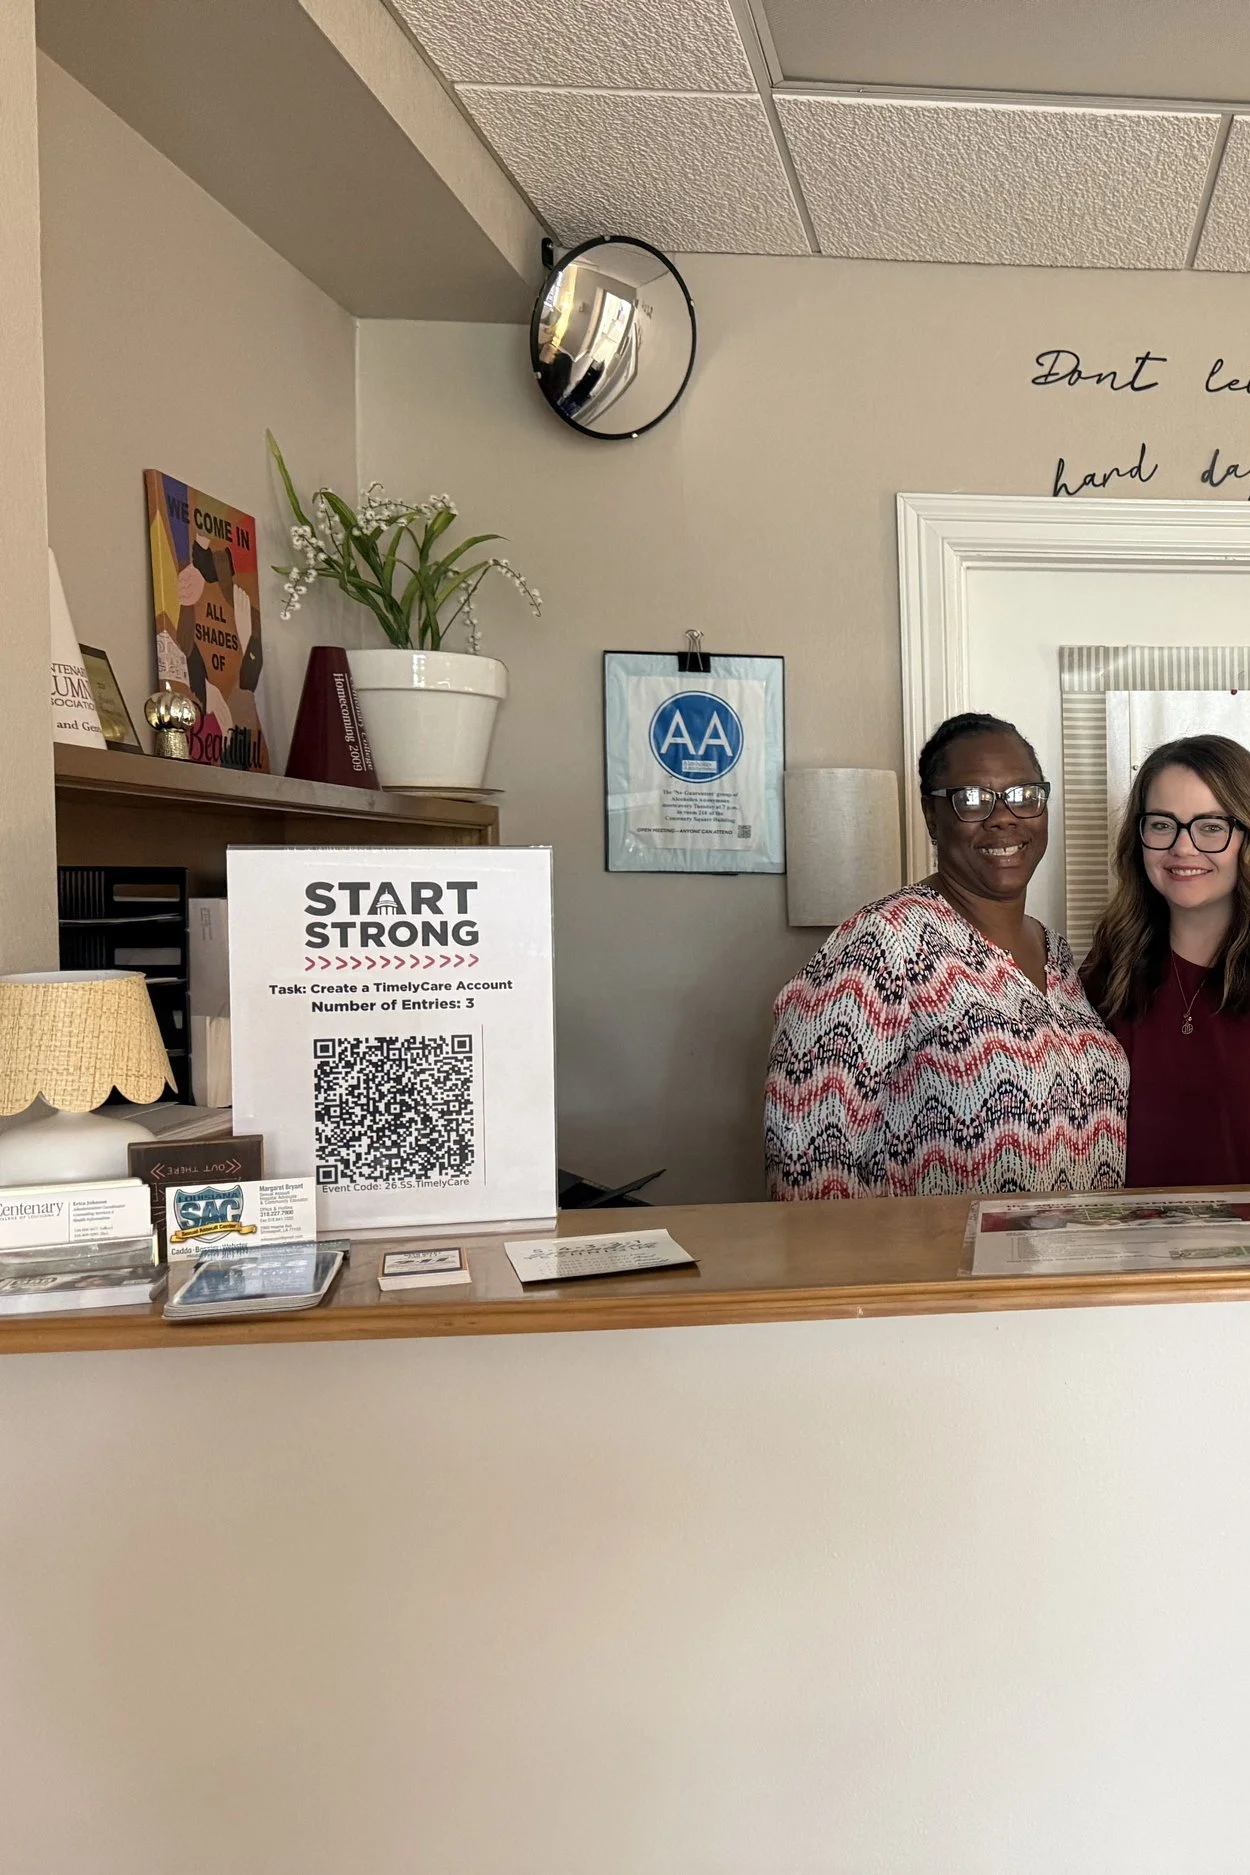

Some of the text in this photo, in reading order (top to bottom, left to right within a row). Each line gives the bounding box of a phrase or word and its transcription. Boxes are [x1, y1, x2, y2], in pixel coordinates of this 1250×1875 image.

[1032, 350, 1167, 392] Dont
[1053, 443, 1158, 497] hard
[167, 495, 250, 551] WE COME IN
[206, 602, 226, 624] ALL
[195, 623, 239, 651] SHADES
[211, 653, 226, 672] OF
[57, 719, 79, 730] and
[332, 672, 363, 771] Homecoming 2009
[660, 709, 734, 757] AA
[304, 881, 478, 916] START
[305, 920, 479, 948] STRONG
[269, 980, 513, 995] Task: Create a TimelyCare Account
[311, 998, 475, 1013] Number of Entries: 3
[167, 1163, 225, 1175] OUT THERE
[179, 1192, 238, 1202] LOUISIANA
[322, 1178, 470, 1193] Event Code: 26.SS.TimelyCare
[180, 1199, 241, 1230] SAC
[171, 1247, 192, 1255] Caddo
